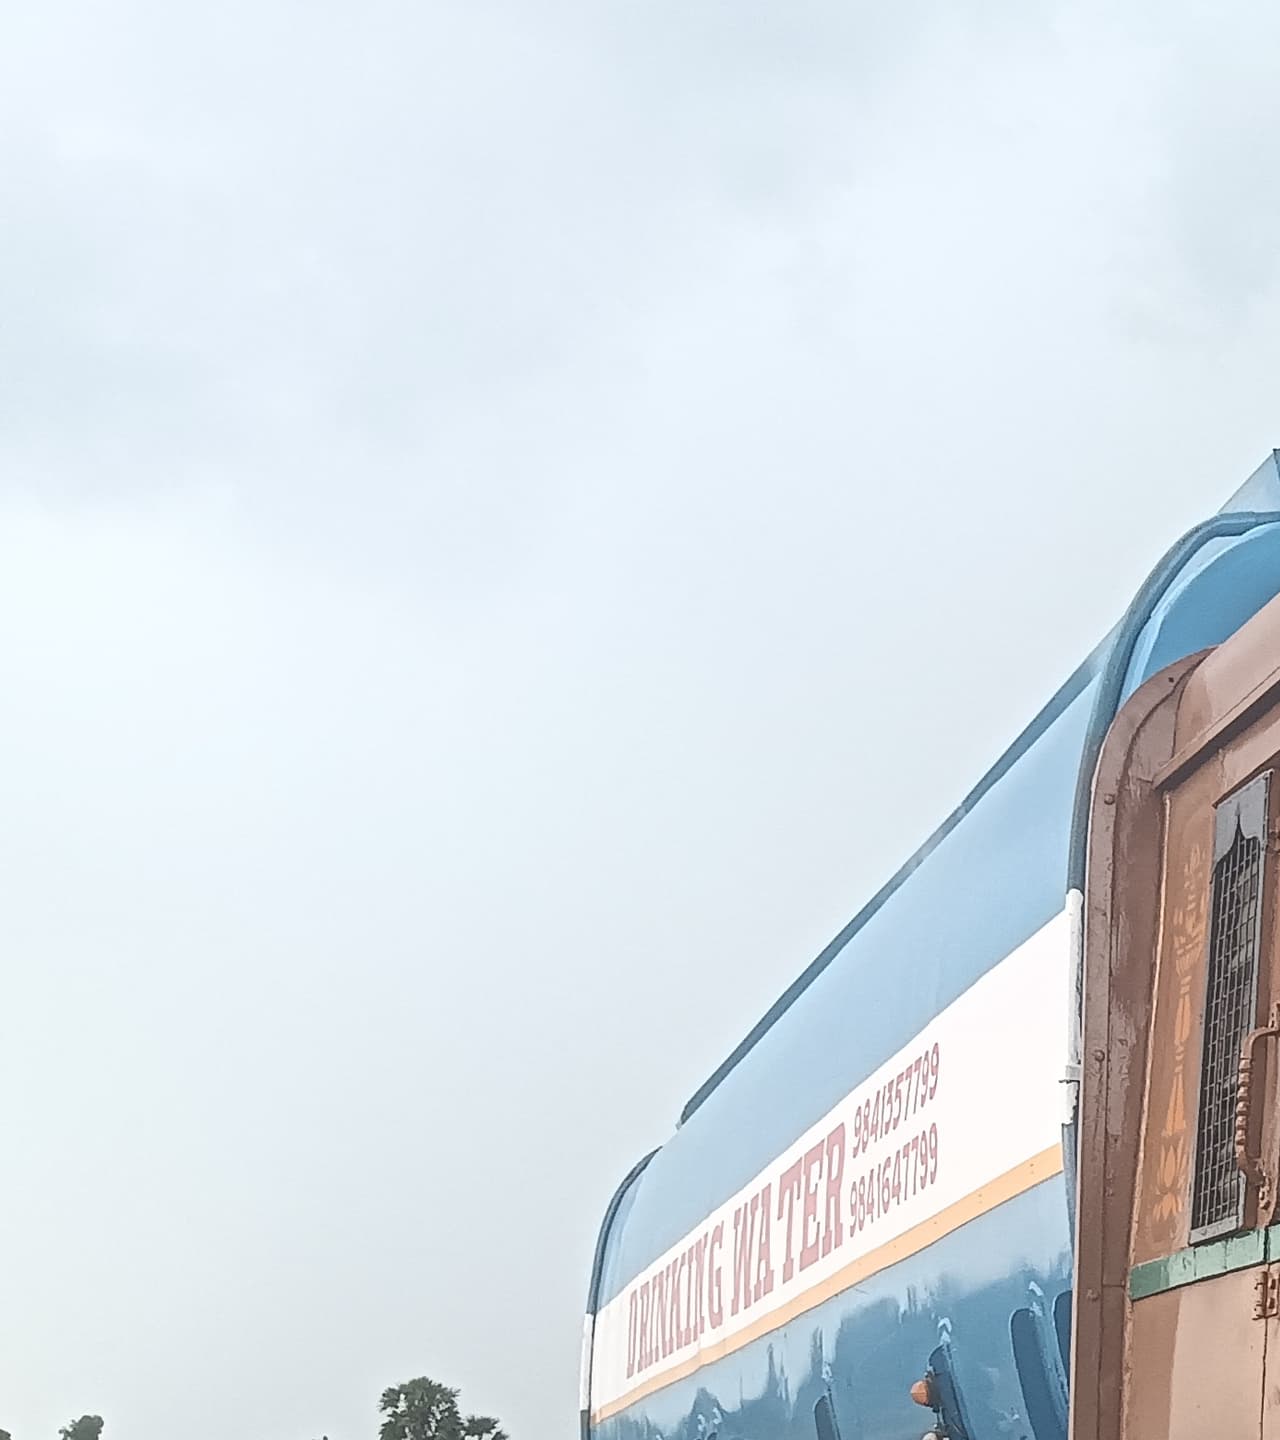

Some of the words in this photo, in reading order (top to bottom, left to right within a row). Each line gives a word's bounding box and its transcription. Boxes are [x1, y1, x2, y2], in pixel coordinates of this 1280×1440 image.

[852, 1042, 940, 1159] 9841357799
[849, 1122, 938, 1238] 9841647799
[626, 1221, 724, 1380] DRINKING
[730, 1122, 846, 1317] WATER
